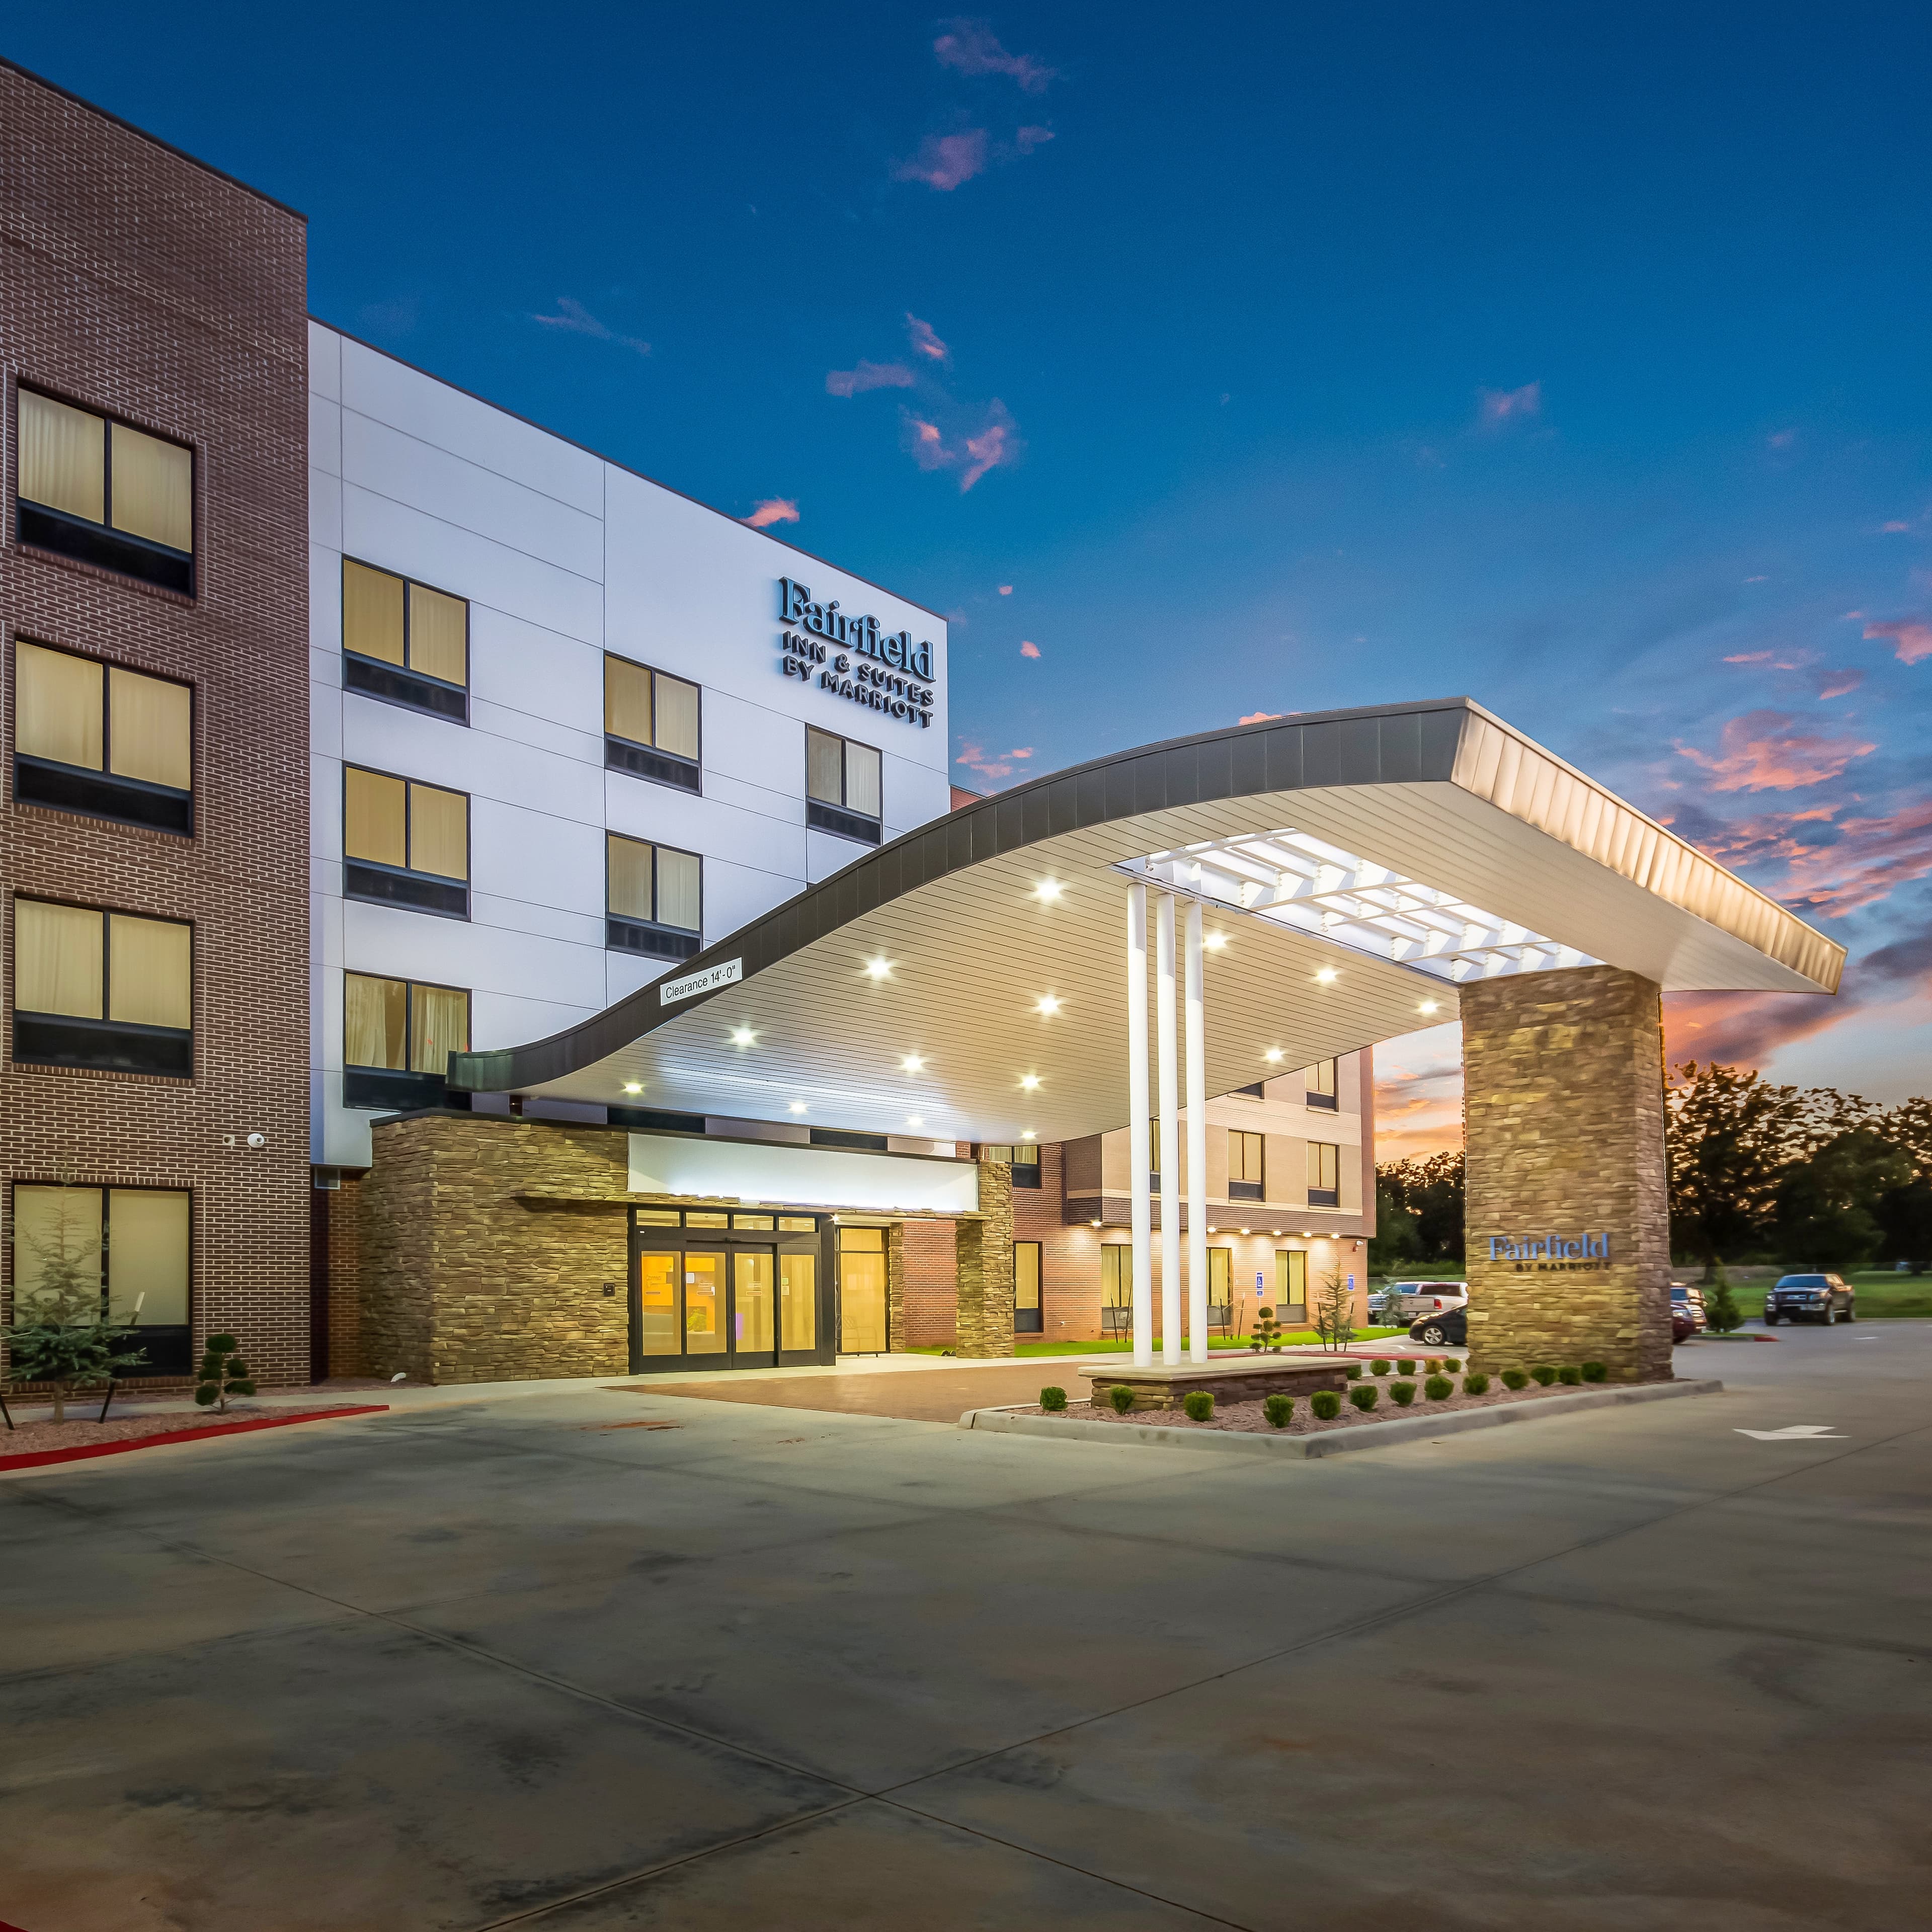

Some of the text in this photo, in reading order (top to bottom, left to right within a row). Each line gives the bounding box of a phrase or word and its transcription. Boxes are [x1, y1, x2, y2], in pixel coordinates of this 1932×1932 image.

[779, 576, 936, 683] Fairfield
[782, 631, 934, 706] INN & SUITES
[783, 655, 933, 729] BY MARRIOTT
[666, 977, 708, 999] Clearance
[1489, 1233, 1609, 1260] Fairfield
